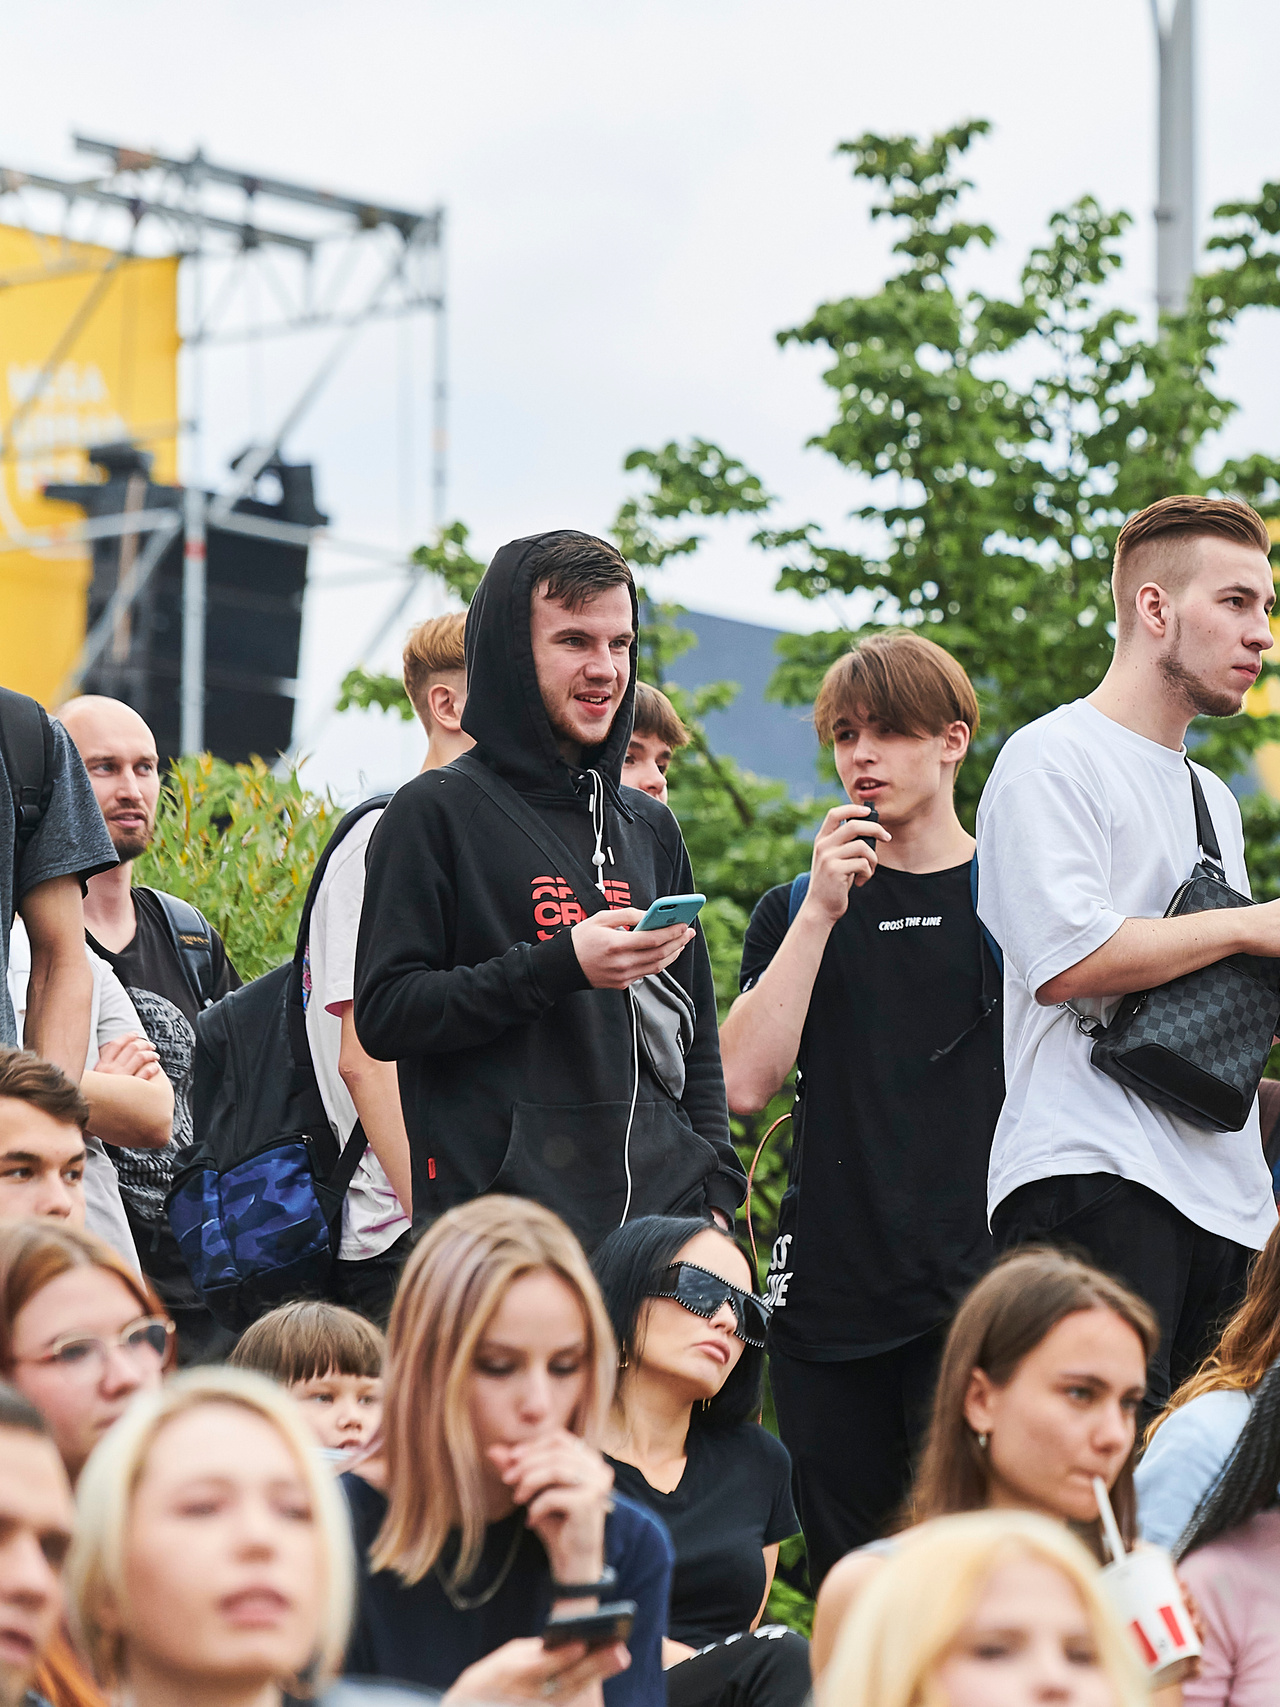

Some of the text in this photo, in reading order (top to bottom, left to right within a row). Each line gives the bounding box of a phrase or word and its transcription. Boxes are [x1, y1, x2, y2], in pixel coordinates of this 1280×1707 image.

[878, 916, 943, 931] CROSS THE LINE
